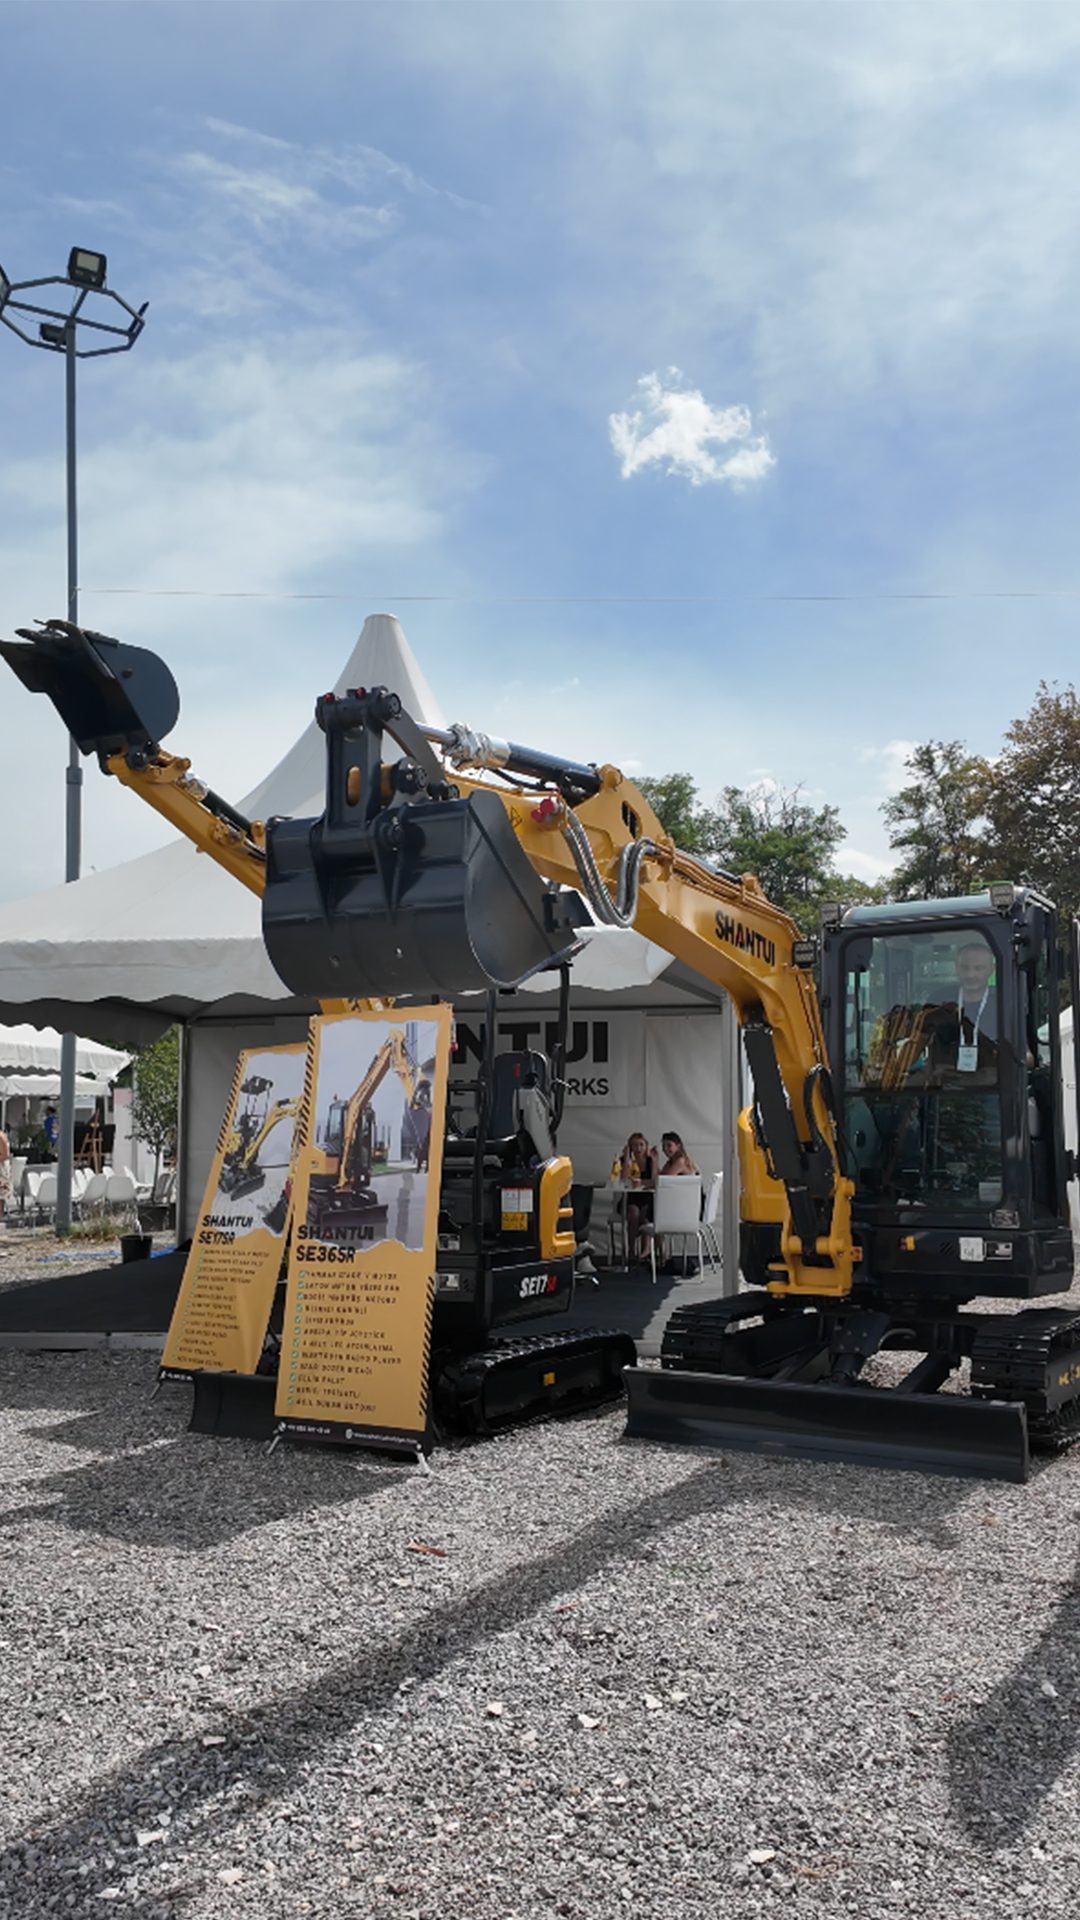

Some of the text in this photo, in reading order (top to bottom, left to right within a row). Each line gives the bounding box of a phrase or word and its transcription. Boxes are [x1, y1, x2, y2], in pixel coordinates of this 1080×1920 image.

[715, 910, 775, 967] SHANTUI
[202, 1215, 254, 1227] SHANTUI
[297, 1224, 374, 1240] SHANTUI
